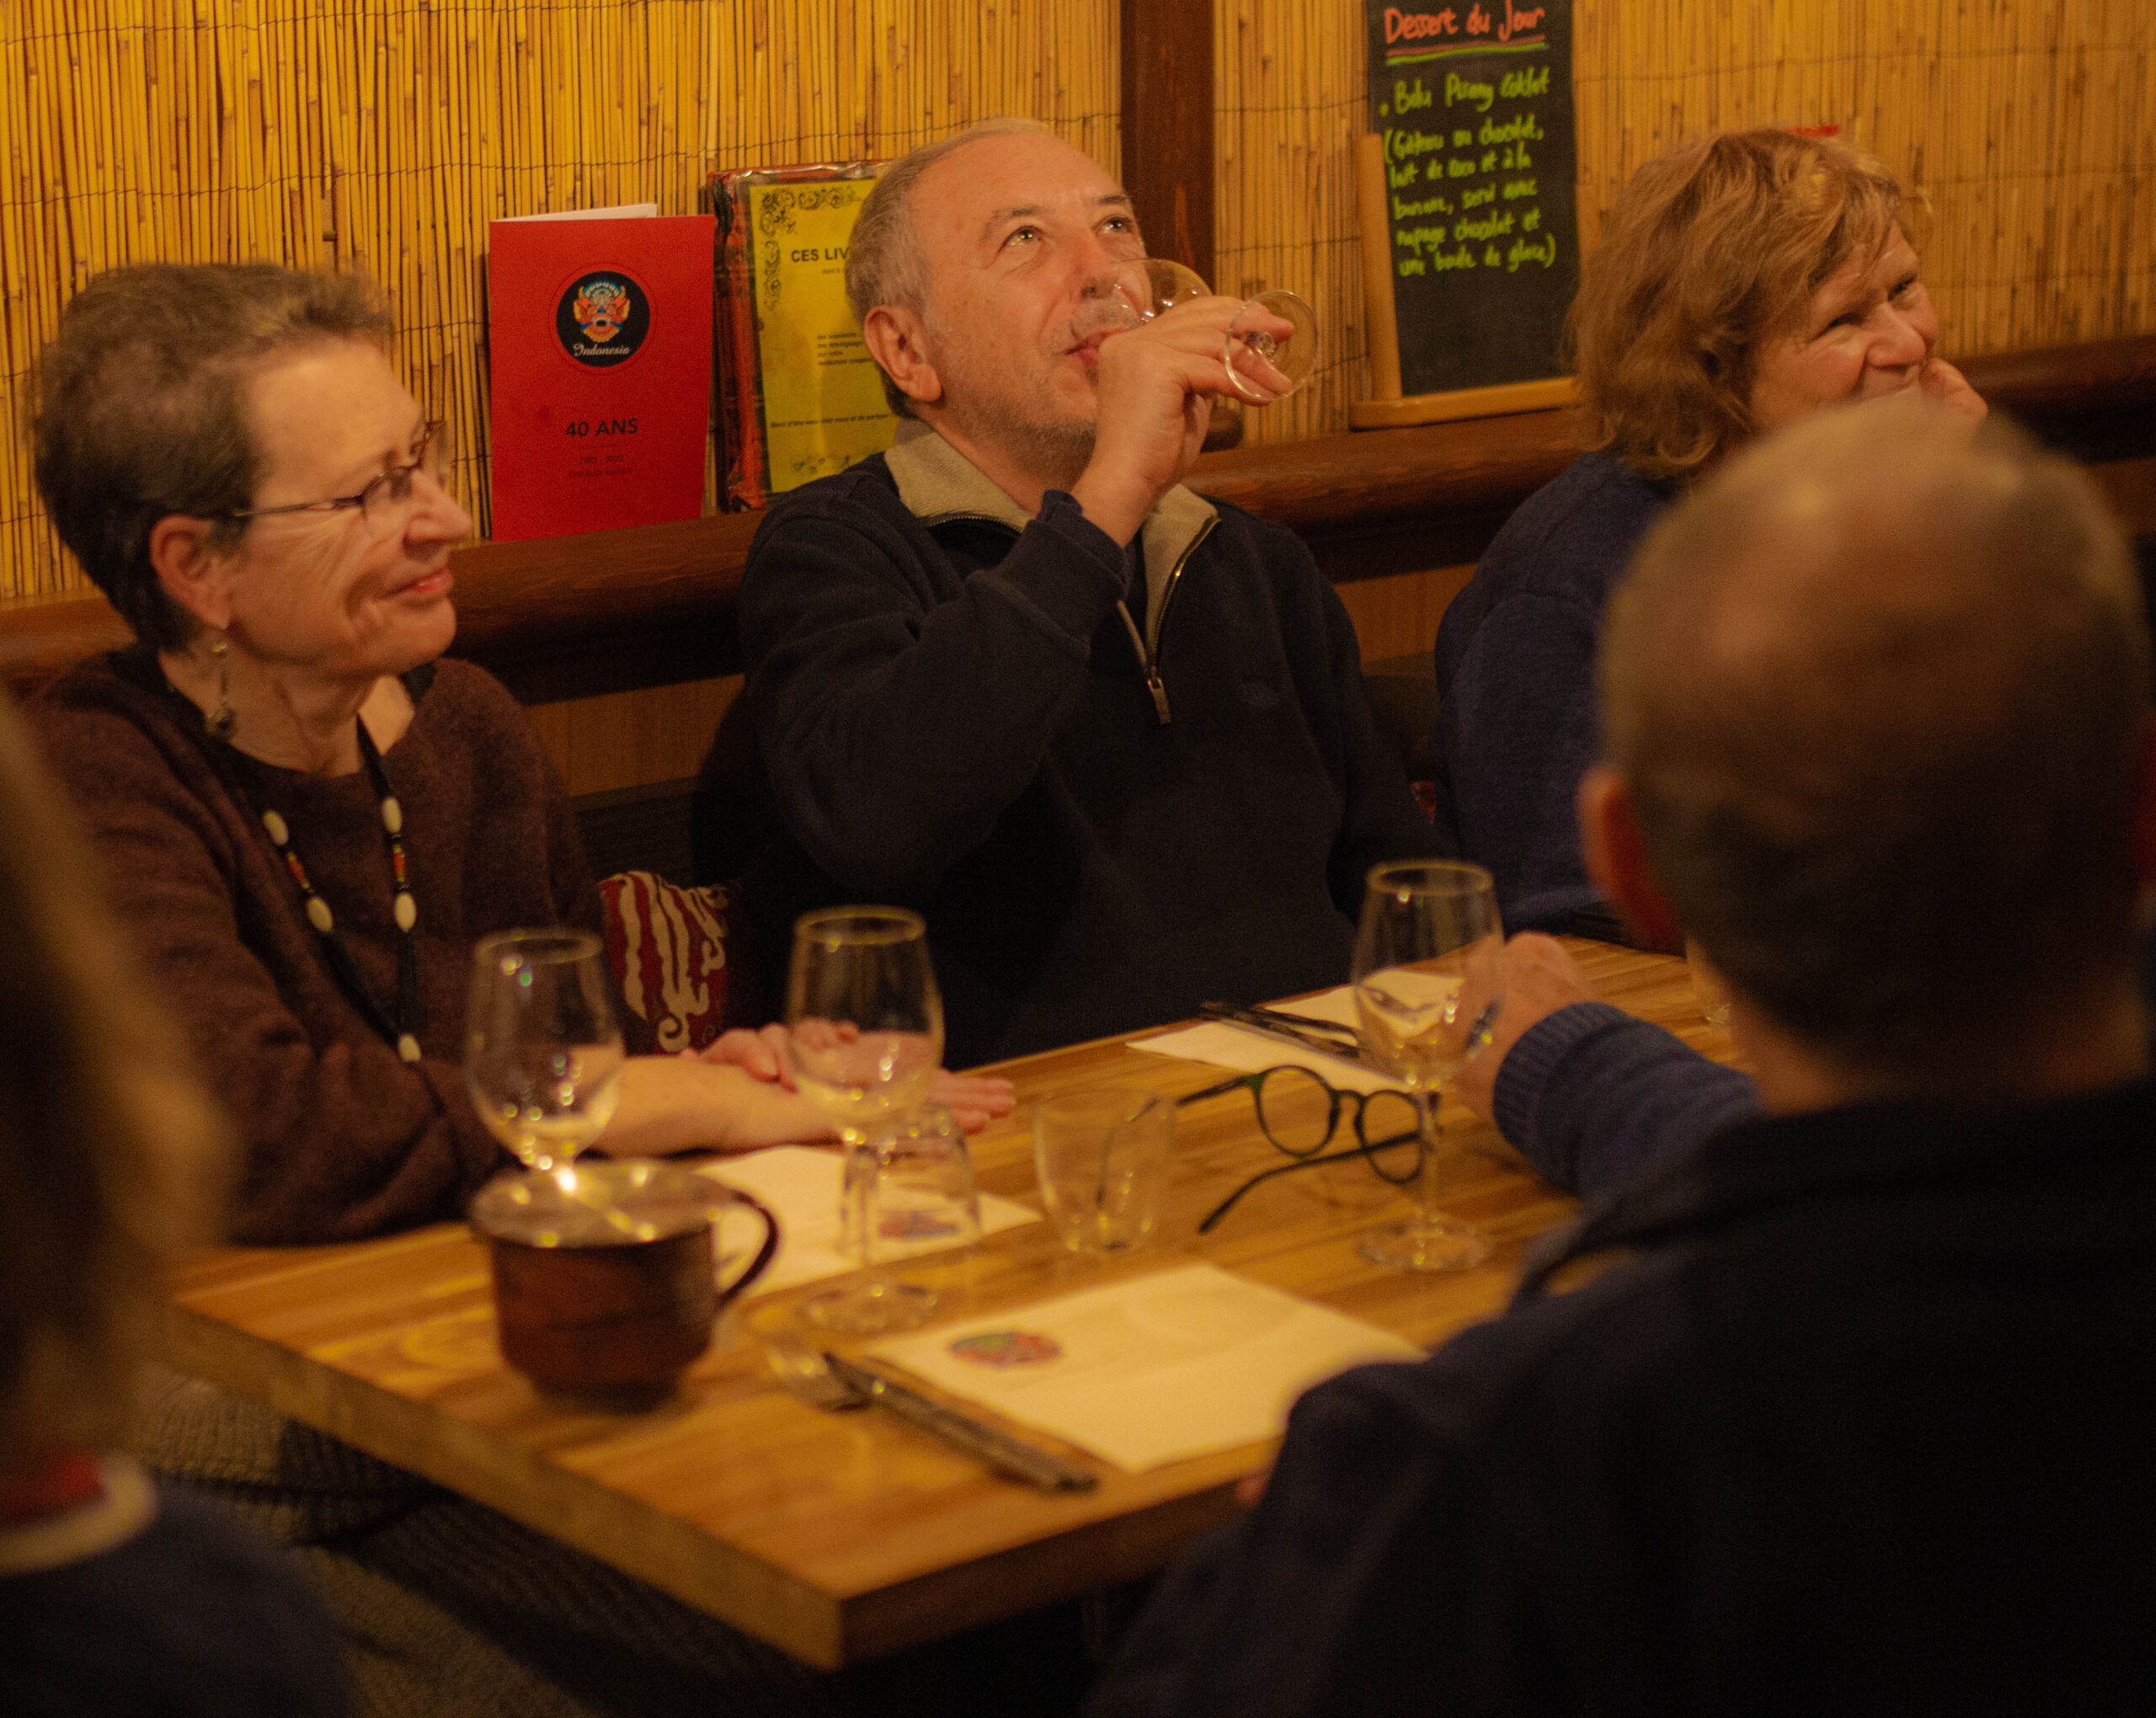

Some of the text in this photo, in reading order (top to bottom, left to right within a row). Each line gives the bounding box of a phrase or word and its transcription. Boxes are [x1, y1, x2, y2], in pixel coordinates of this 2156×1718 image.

[1384, 0, 1545, 44] Dessert du Jour
[791, 248, 819, 263] CES
[573, 342, 632, 358] Indonesia
[565, 418, 639, 438] 40 ANS
